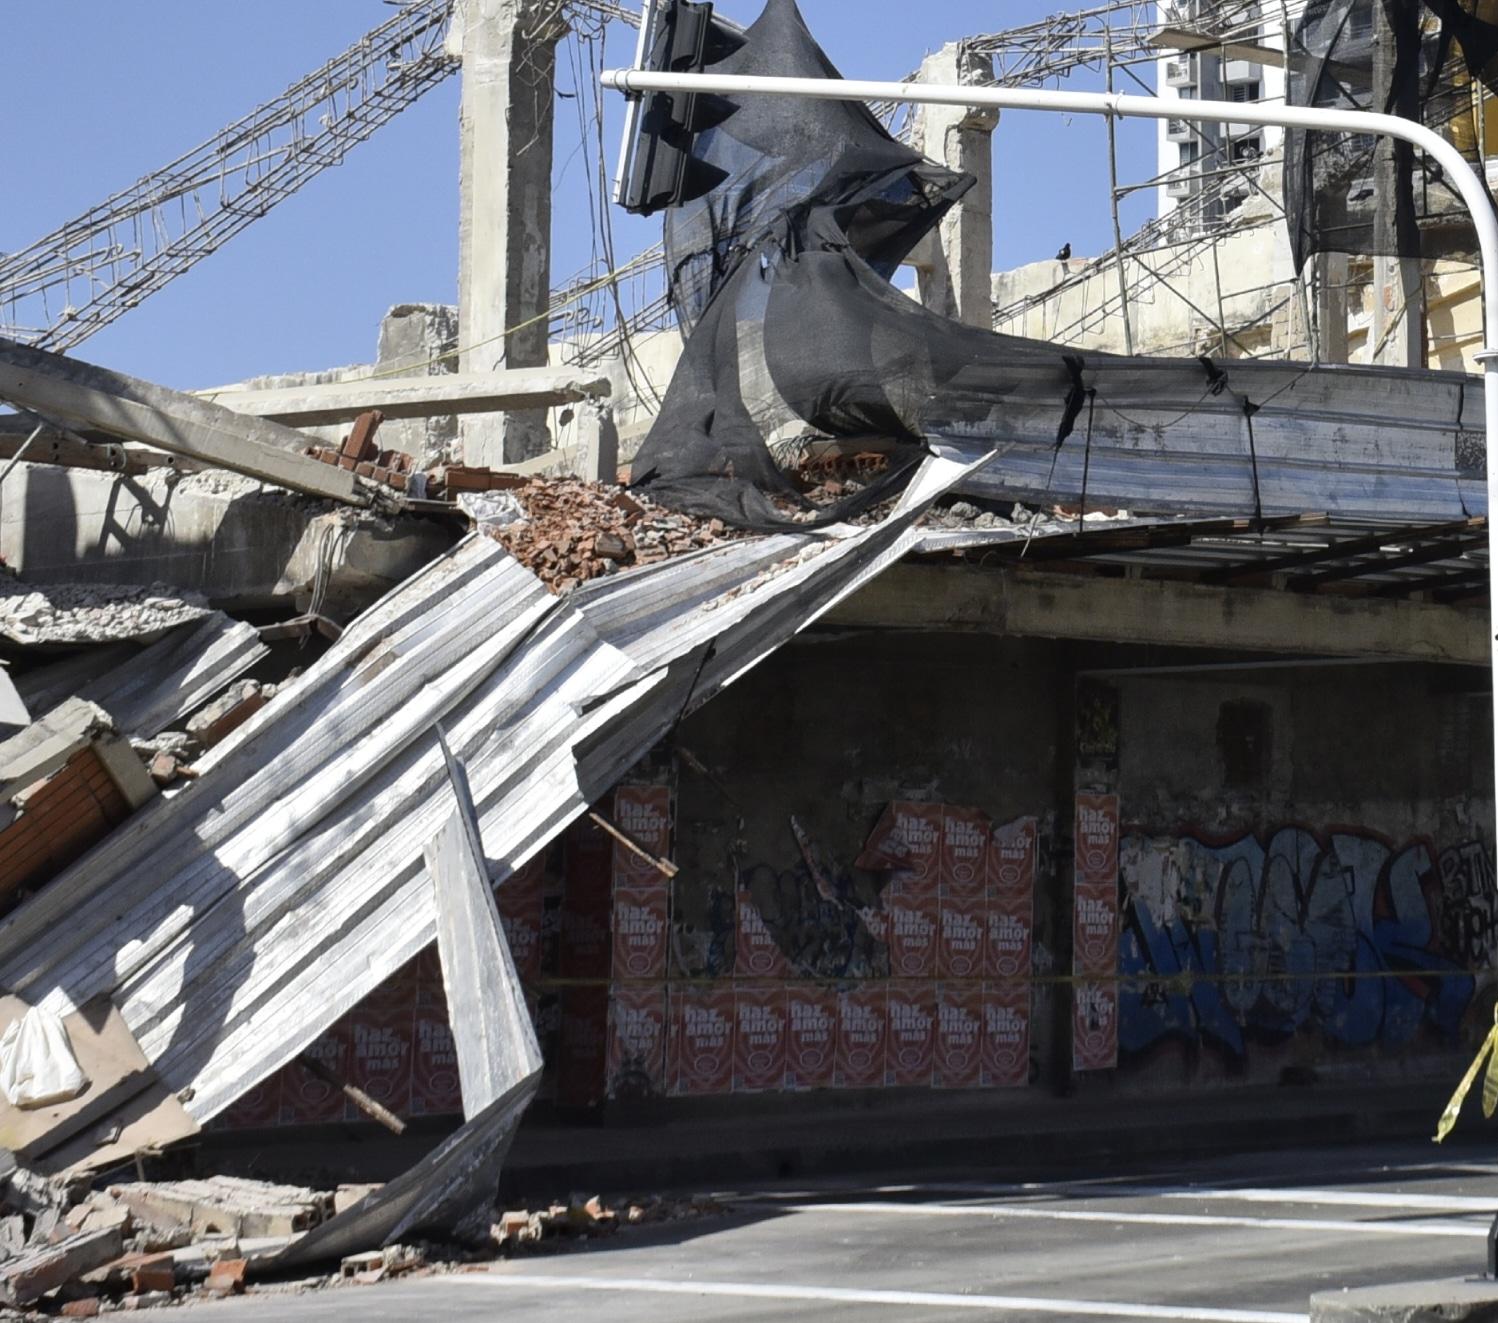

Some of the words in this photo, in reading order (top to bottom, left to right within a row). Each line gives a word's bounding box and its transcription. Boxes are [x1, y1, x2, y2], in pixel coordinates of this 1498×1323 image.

[622, 817, 667, 829] amor
[1081, 821, 1115, 834] amor
[946, 832, 986, 846] amor
[1079, 911, 1114, 924] amor
[619, 919, 663, 933] amor
[895, 921, 935, 936] amor
[943, 925, 983, 939] amor
[990, 927, 1029, 940] amor
[686, 1021, 731, 1036] amor
[740, 1018, 785, 1032] amor
[792, 1016, 834, 1031] amor
[841, 1018, 884, 1032] amor
[893, 1016, 933, 1030] amor
[940, 1019, 980, 1033] amor
[987, 1018, 1027, 1033] amor
[355, 1042, 410, 1057] amor
